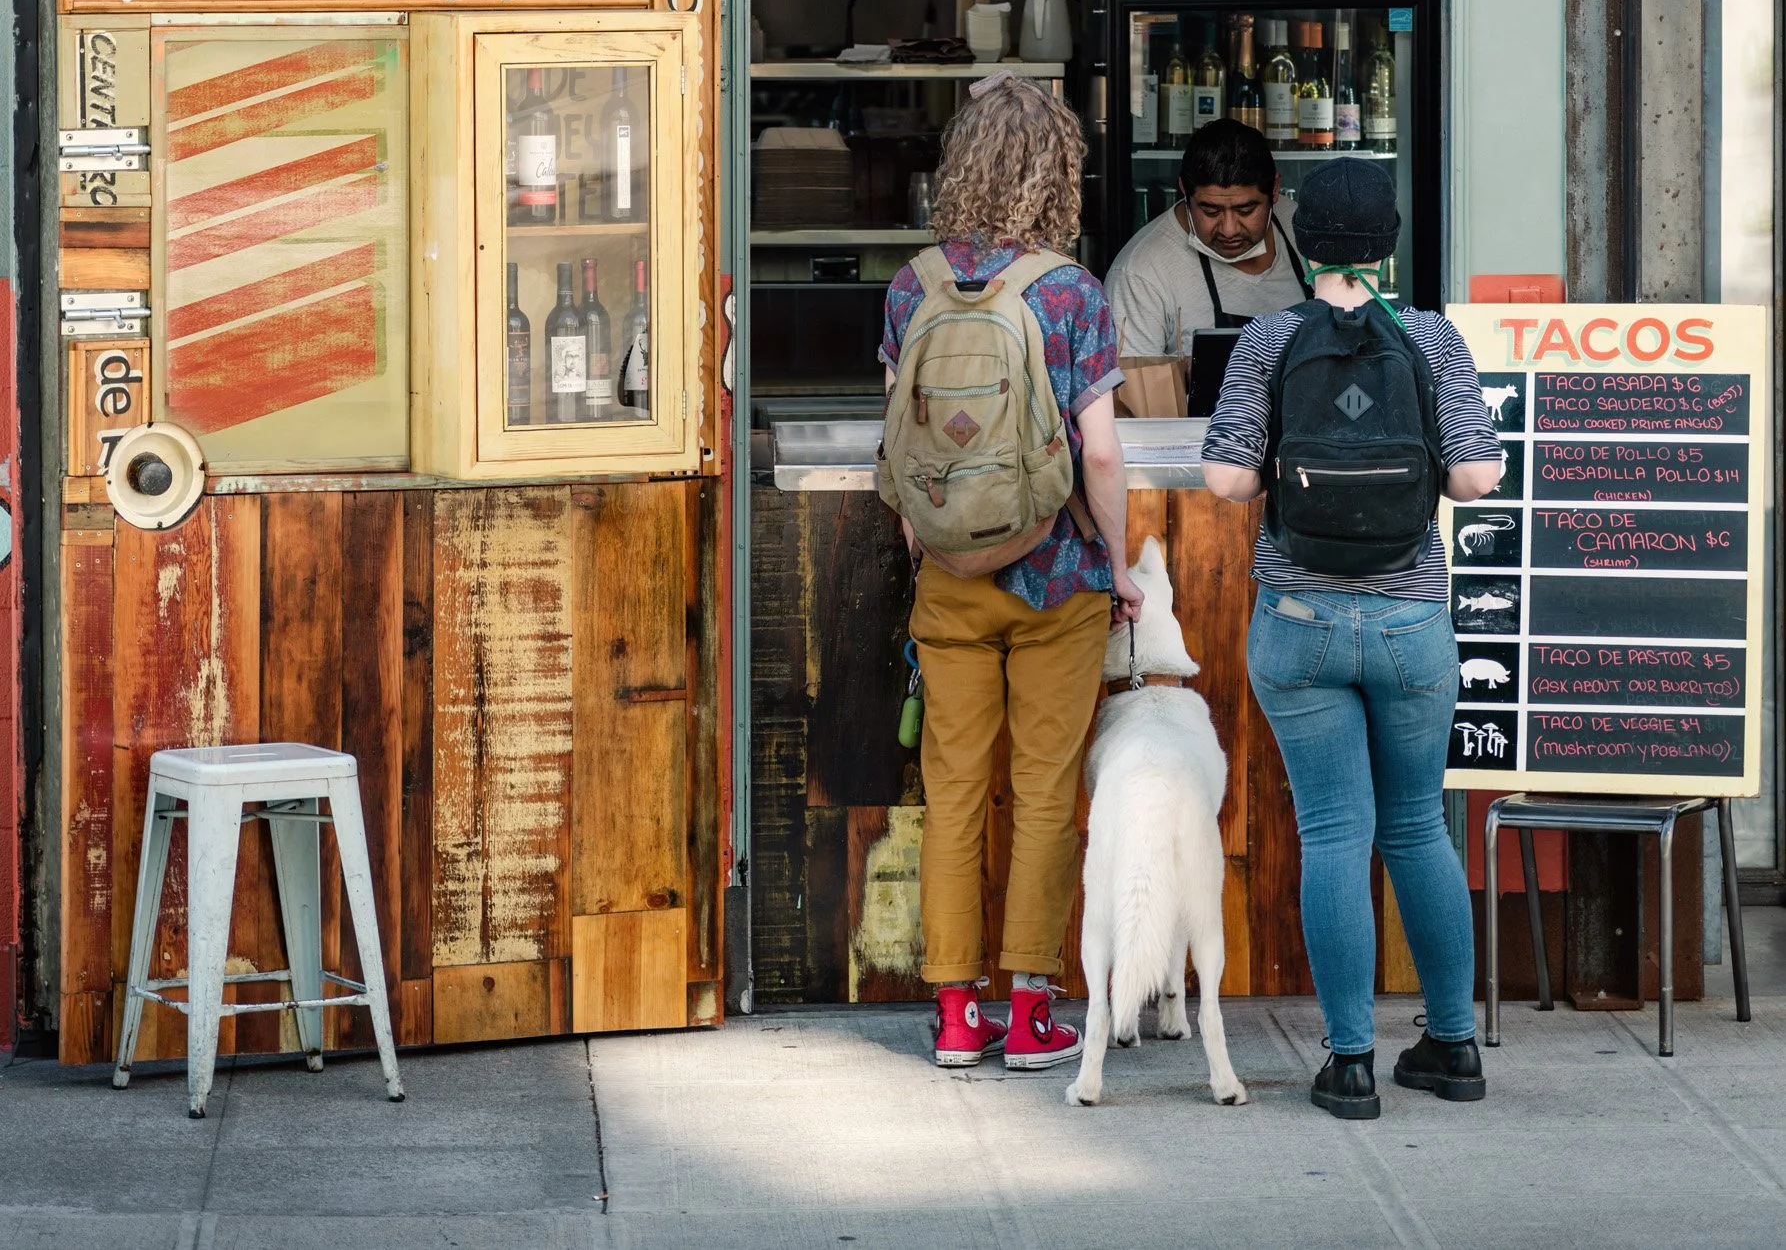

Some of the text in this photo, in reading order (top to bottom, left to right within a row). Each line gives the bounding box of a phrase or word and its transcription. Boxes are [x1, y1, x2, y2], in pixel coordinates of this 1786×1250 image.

[1498, 317, 1715, 365] TACOS
[1539, 374, 1597, 392] TACO
[1602, 376, 1667, 392] ASADA
[1539, 396, 1590, 412] TACO
[1537, 414, 1580, 431] (SLOW
[1584, 418, 1627, 431] COOKED
[1674, 416, 1723, 431] ANGUS)
[1537, 444, 1704, 463] TACO DE POLLO $5
[1541, 463, 1740, 483] QUESADILLA POLLO $14
[1593, 489, 1653, 502] (CHICKEN)
[1536, 511, 1637, 529] TACO DE
[1577, 530, 1731, 551] CAMARON $6
[1533, 646, 1731, 670] TACO DE PASTOR $5
[1532, 677, 1569, 694] (ASK
[1573, 679, 1621, 694] ABOUT
[1628, 679, 1658, 693] OUR
[1533, 714, 1701, 734] TACO DE VEGGIE $4
